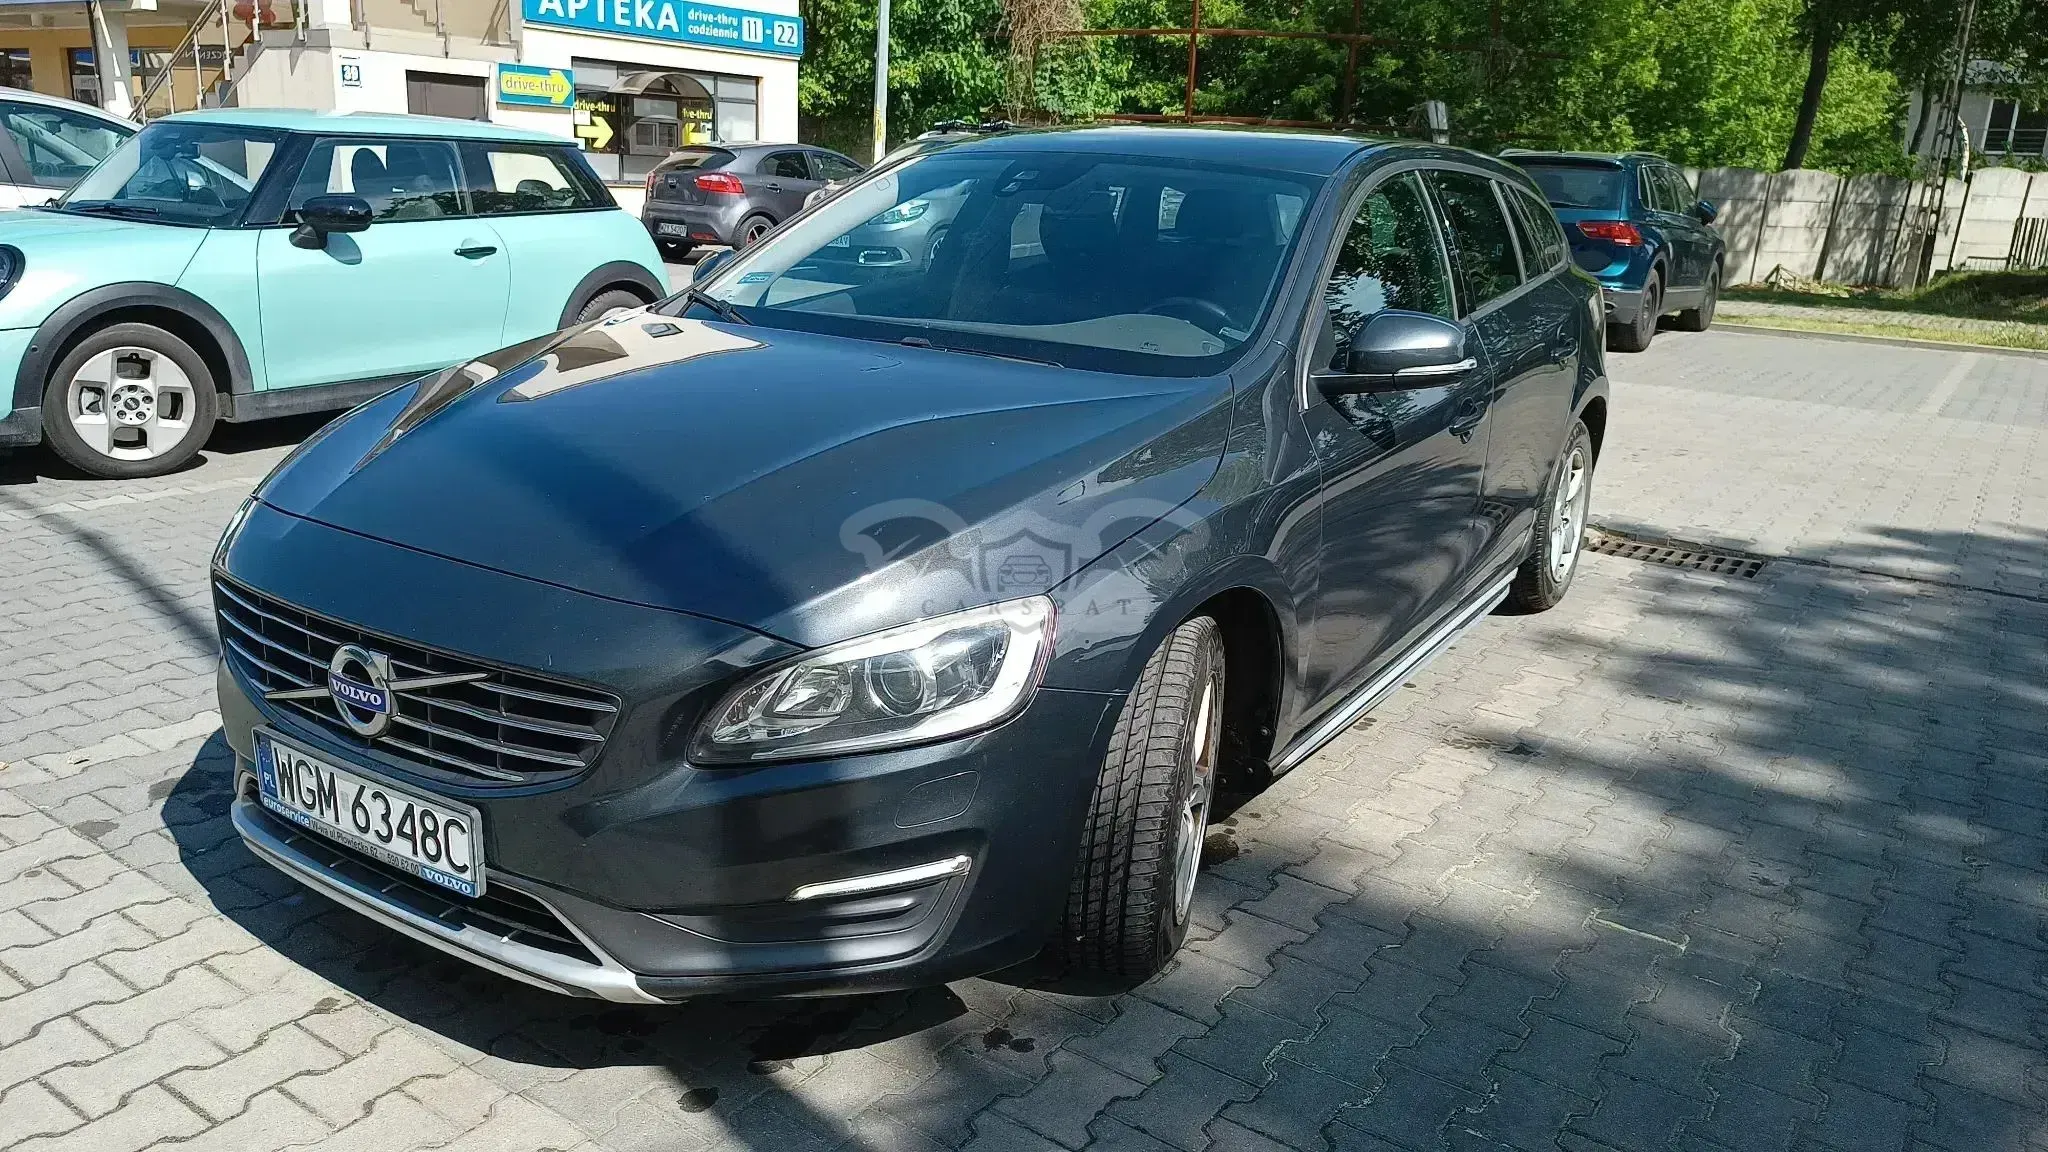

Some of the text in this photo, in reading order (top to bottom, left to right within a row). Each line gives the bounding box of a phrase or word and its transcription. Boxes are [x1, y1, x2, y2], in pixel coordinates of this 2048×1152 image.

[538, 0, 679, 33] APTEKA
[688, 8, 738, 26] drive-thru
[688, 24, 738, 39] codziennie
[777, 24, 795, 44] 22
[505, 77, 564, 92] drive-thru
[330, 677, 382, 706] VOLVO
[264, 771, 275, 788] PL
[263, 796, 311, 828] euroservice
[274, 747, 469, 874] WGM 6348C
[423, 867, 471, 894] VOLVO
